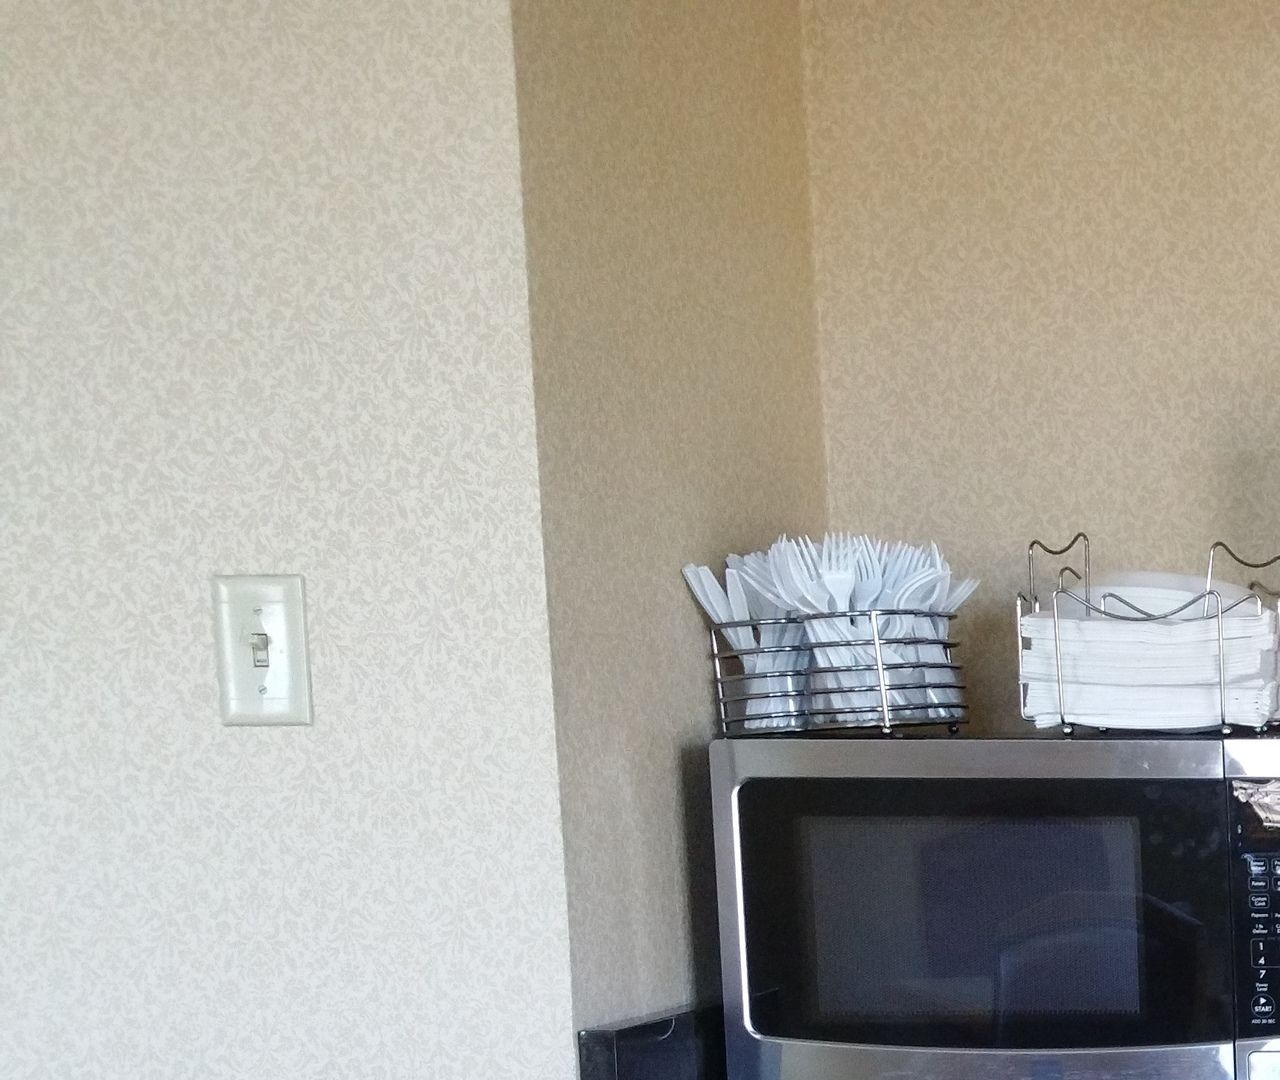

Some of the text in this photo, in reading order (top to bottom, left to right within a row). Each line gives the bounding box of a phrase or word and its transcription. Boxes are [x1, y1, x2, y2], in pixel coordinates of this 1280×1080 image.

[1259, 942, 1264, 951] 1
[1258, 956, 1265, 965] 4
[1259, 969, 1267, 979] 7
